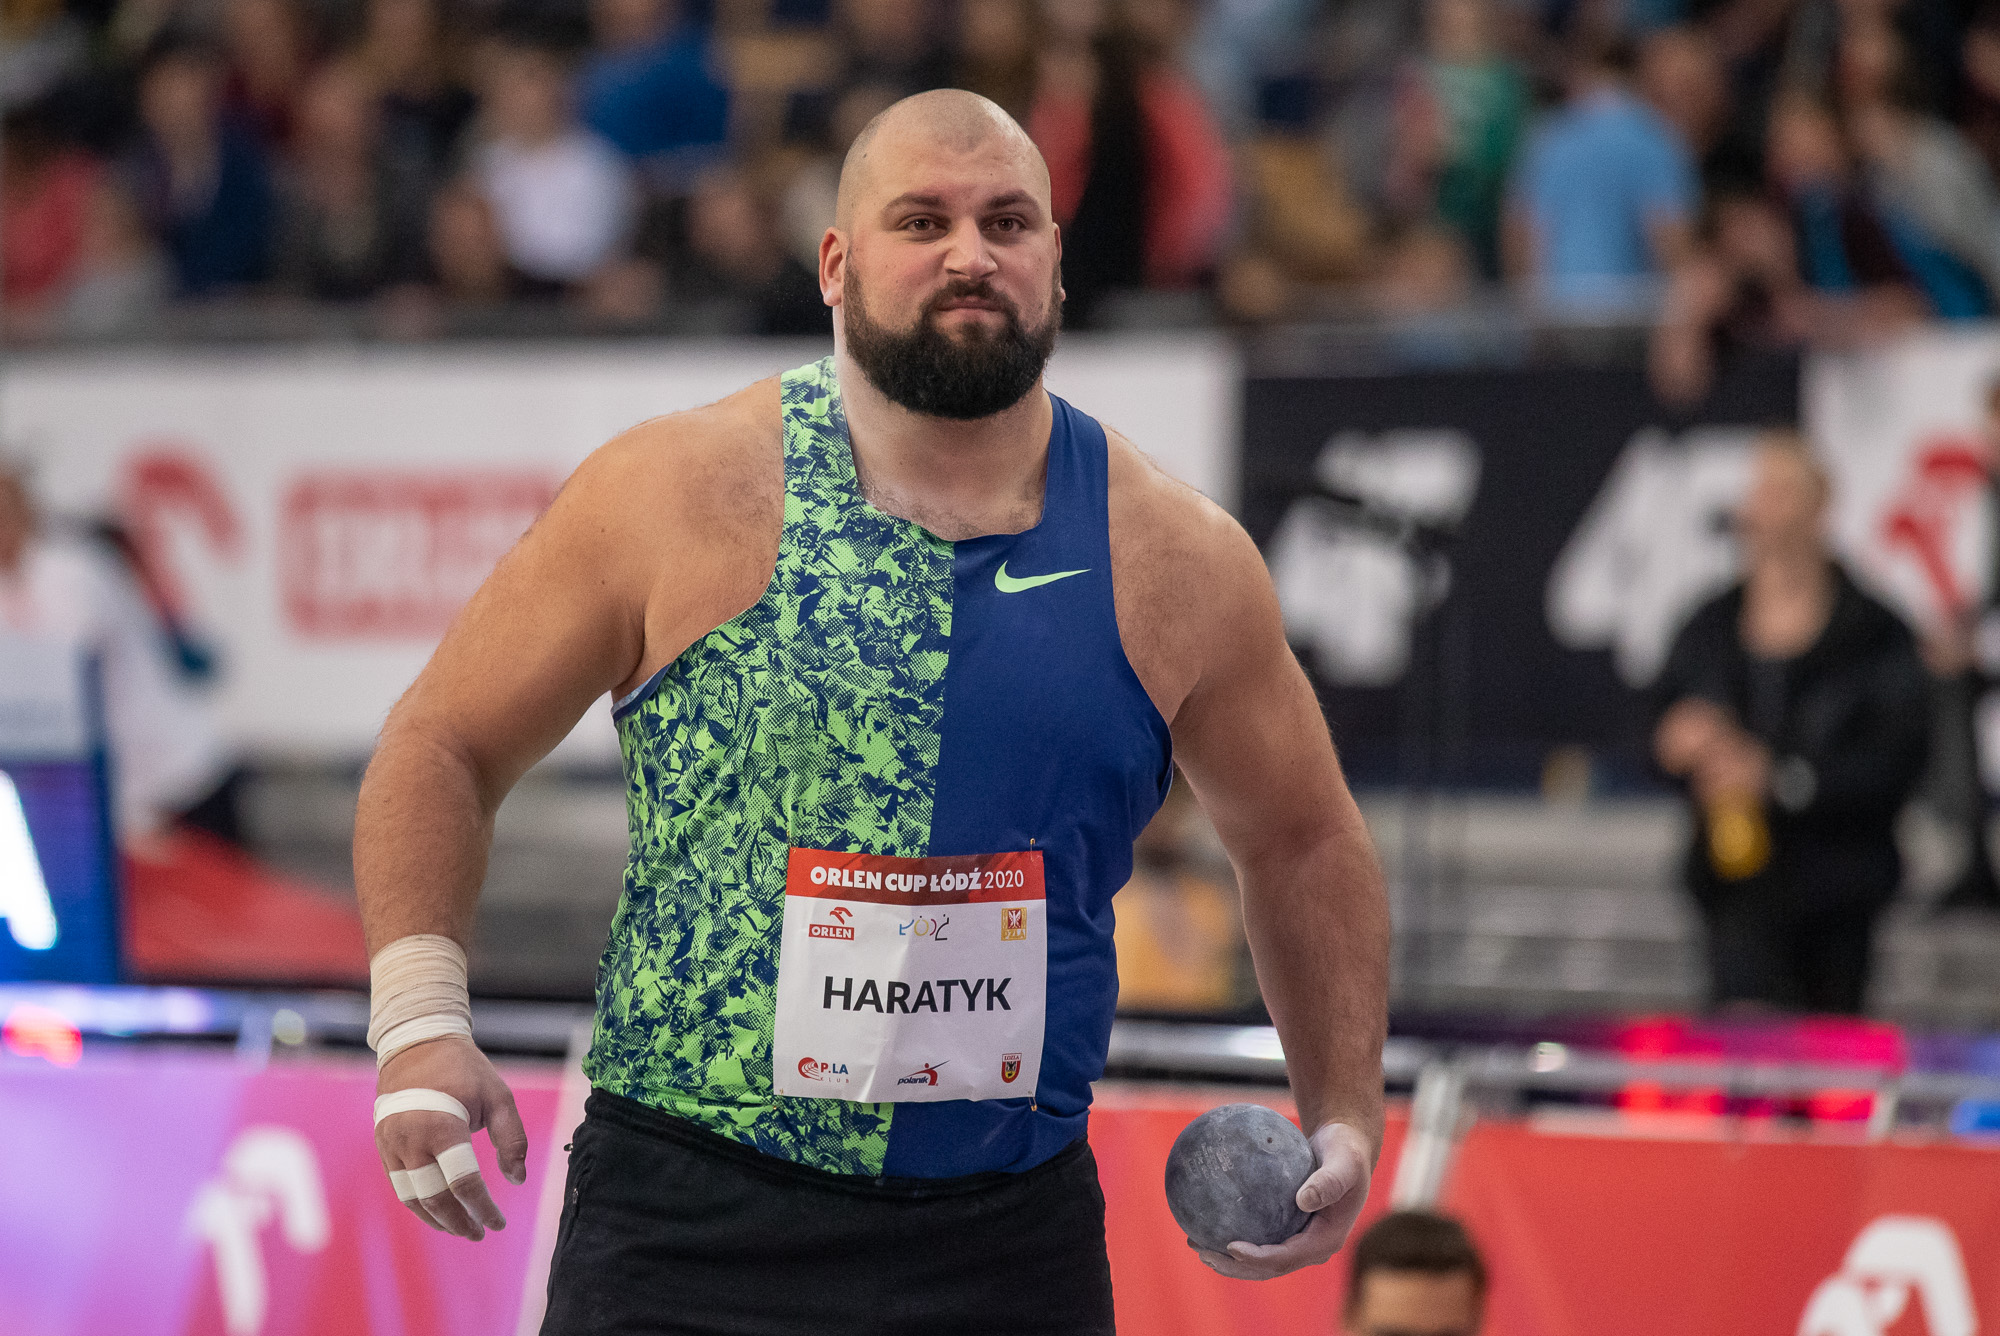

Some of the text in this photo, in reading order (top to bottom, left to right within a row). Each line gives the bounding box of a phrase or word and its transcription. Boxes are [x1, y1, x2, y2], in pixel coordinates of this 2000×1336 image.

[810, 866, 1024, 892] ORLEN CUP ŁÓDŹ 2020
[811, 927, 852, 939] ORLEN
[823, 976, 1012, 1014] HARATYK
[896, 1076, 930, 1086] polanik
